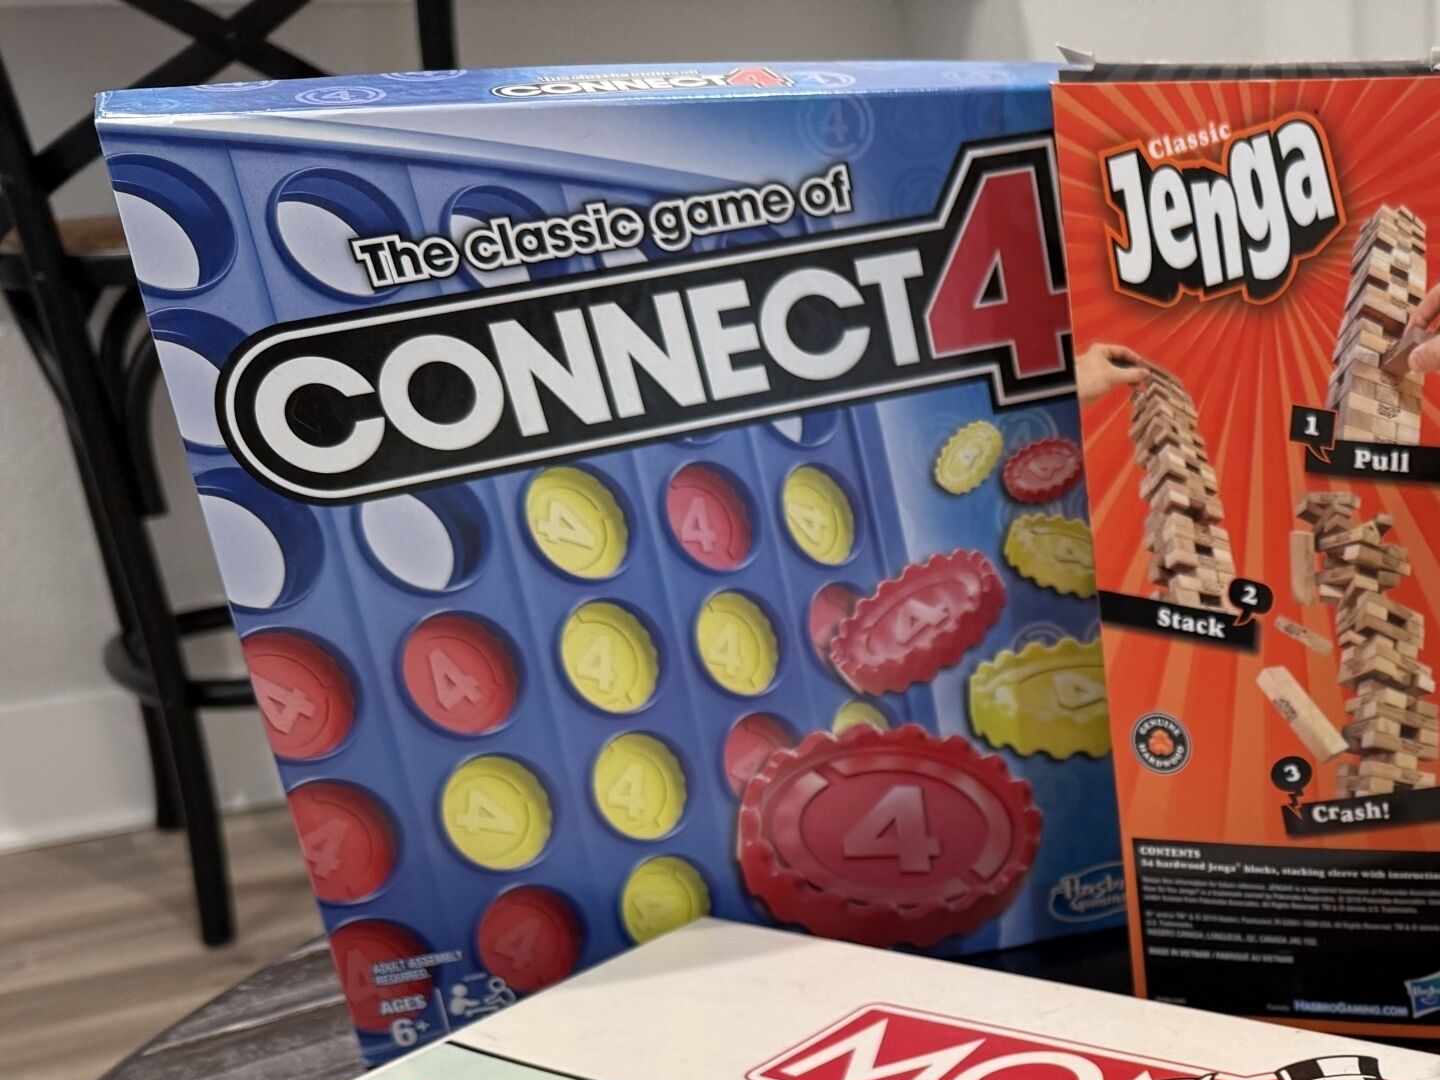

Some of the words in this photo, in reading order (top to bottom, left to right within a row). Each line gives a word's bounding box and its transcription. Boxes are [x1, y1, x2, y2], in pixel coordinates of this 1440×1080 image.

[499, 74, 727, 97] CONNECT
[1148, 121, 1232, 160] Classic
[1108, 118, 1336, 287] Jenga
[349, 235, 460, 288] The
[463, 202, 645, 271] classic
[649, 183, 795, 251] game
[799, 163, 855, 214] of
[254, 249, 923, 474] CONNECT
[928, 169, 1071, 379] 4
[1304, 415, 1320, 437] 1
[1354, 449, 1410, 474] Pull
[1242, 586, 1259, 606] 2
[1156, 607, 1226, 639] Stack
[1282, 764, 1302, 784] 3
[1311, 801, 1390, 825] Crash!
[844, 785, 943, 874] 4
[1139, 846, 1201, 859] CONTENTS
[1156, 859, 1206, 872] hardwood
[1243, 864, 1281, 877] blocks,
[1281, 866, 1326, 880] stacking
[1327, 868, 1359, 879] sleeve
[1360, 868, 1387, 880] with
[380, 994, 427, 1016] AGES
[391, 1017, 431, 1048] 6+
